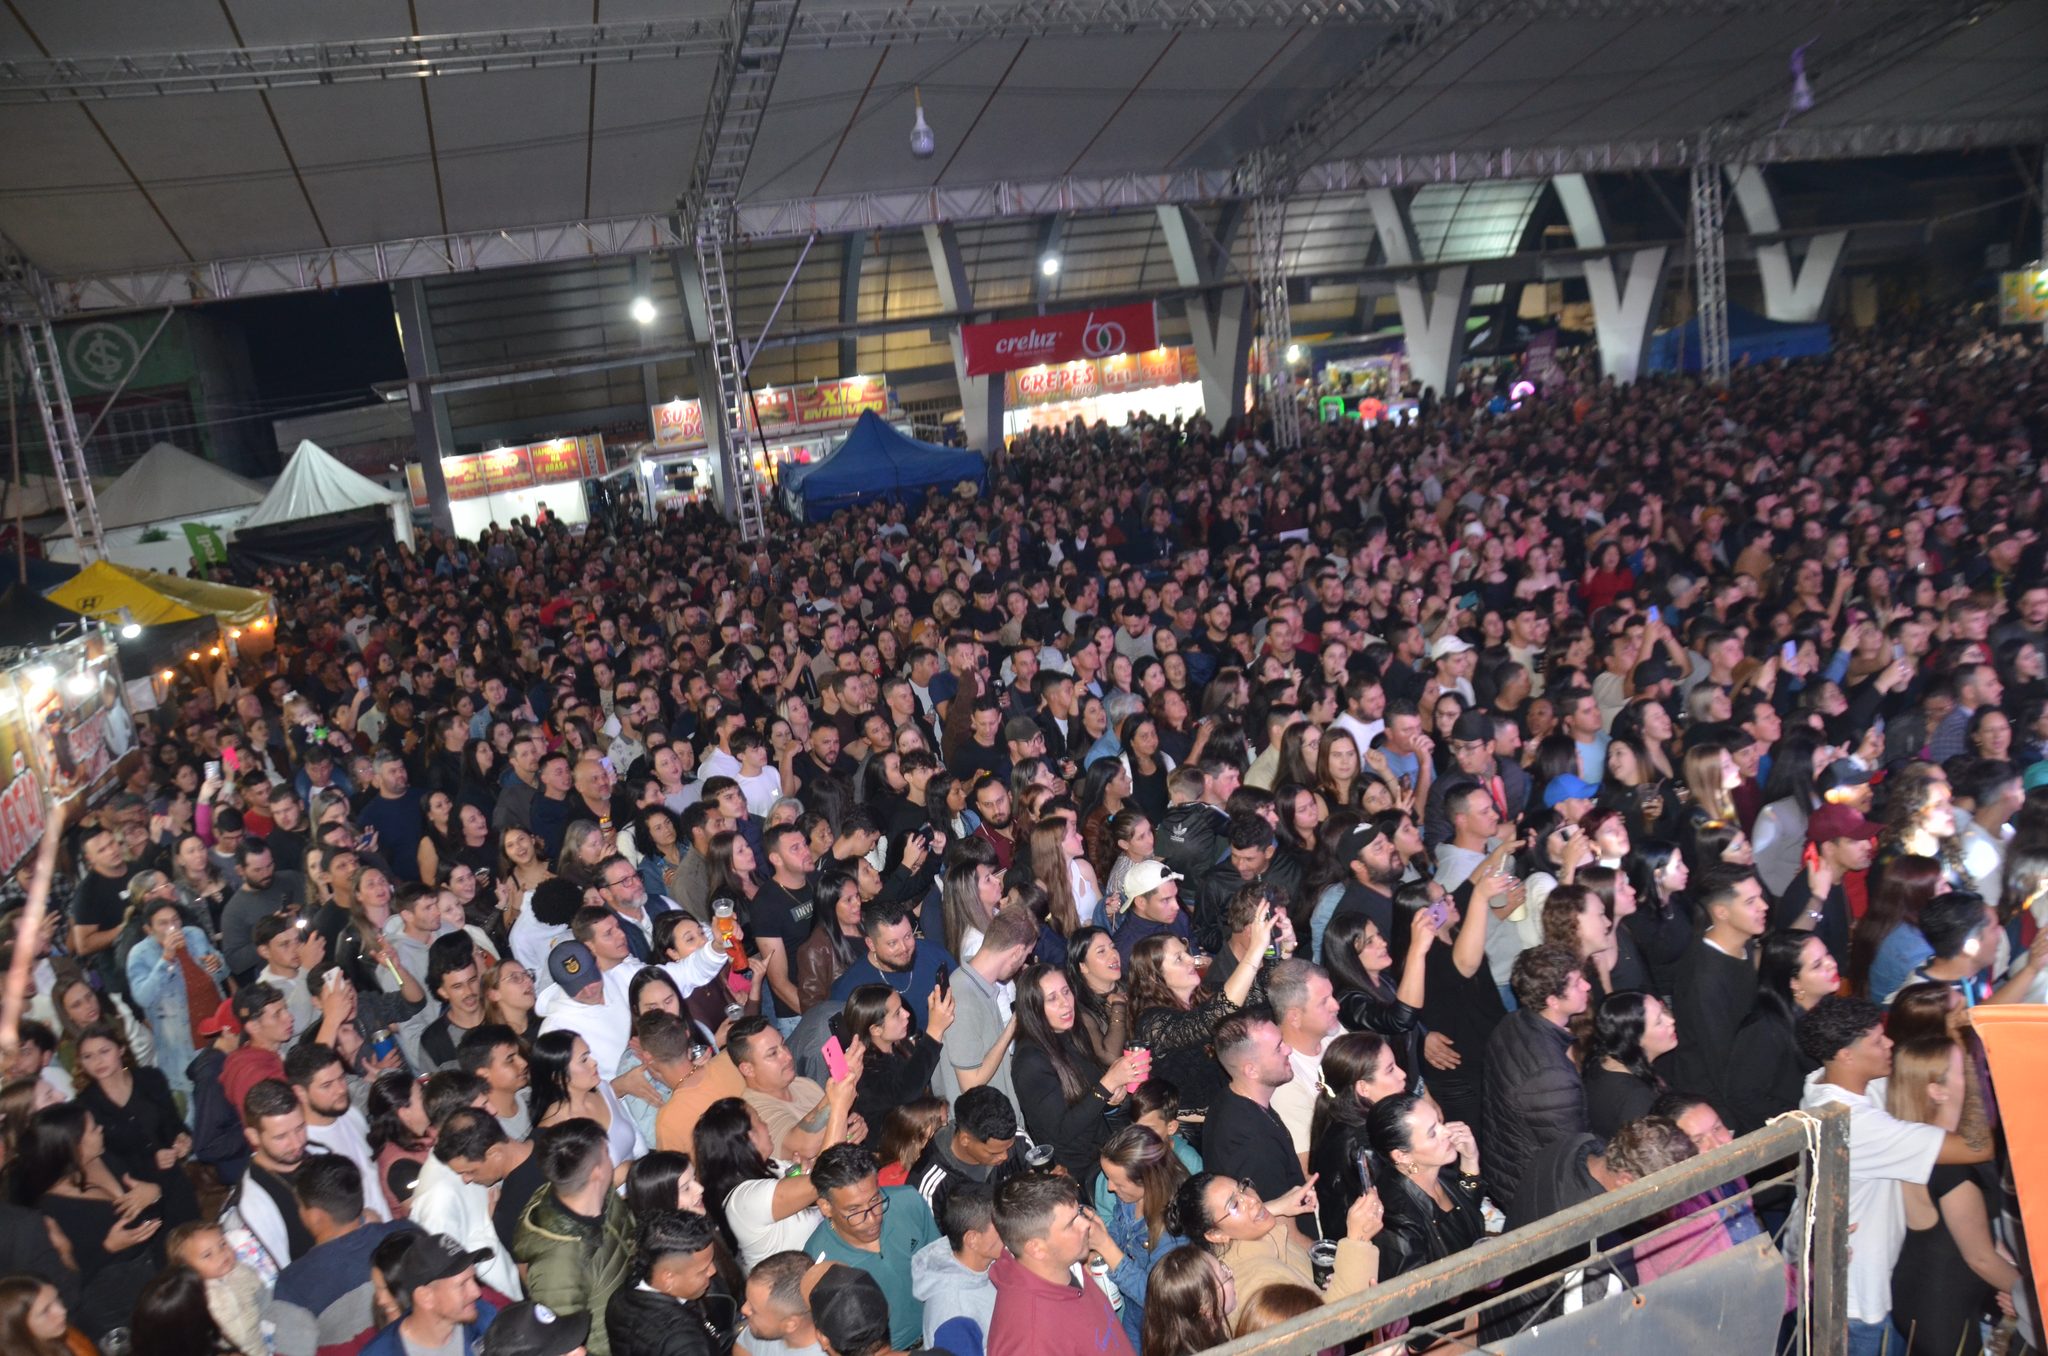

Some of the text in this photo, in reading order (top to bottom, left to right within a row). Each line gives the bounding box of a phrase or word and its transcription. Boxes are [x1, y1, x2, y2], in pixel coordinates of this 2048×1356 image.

[996, 329, 1057, 353] creluz
[1019, 365, 1096, 393] CREPES
[795, 903, 814, 918] INVI
